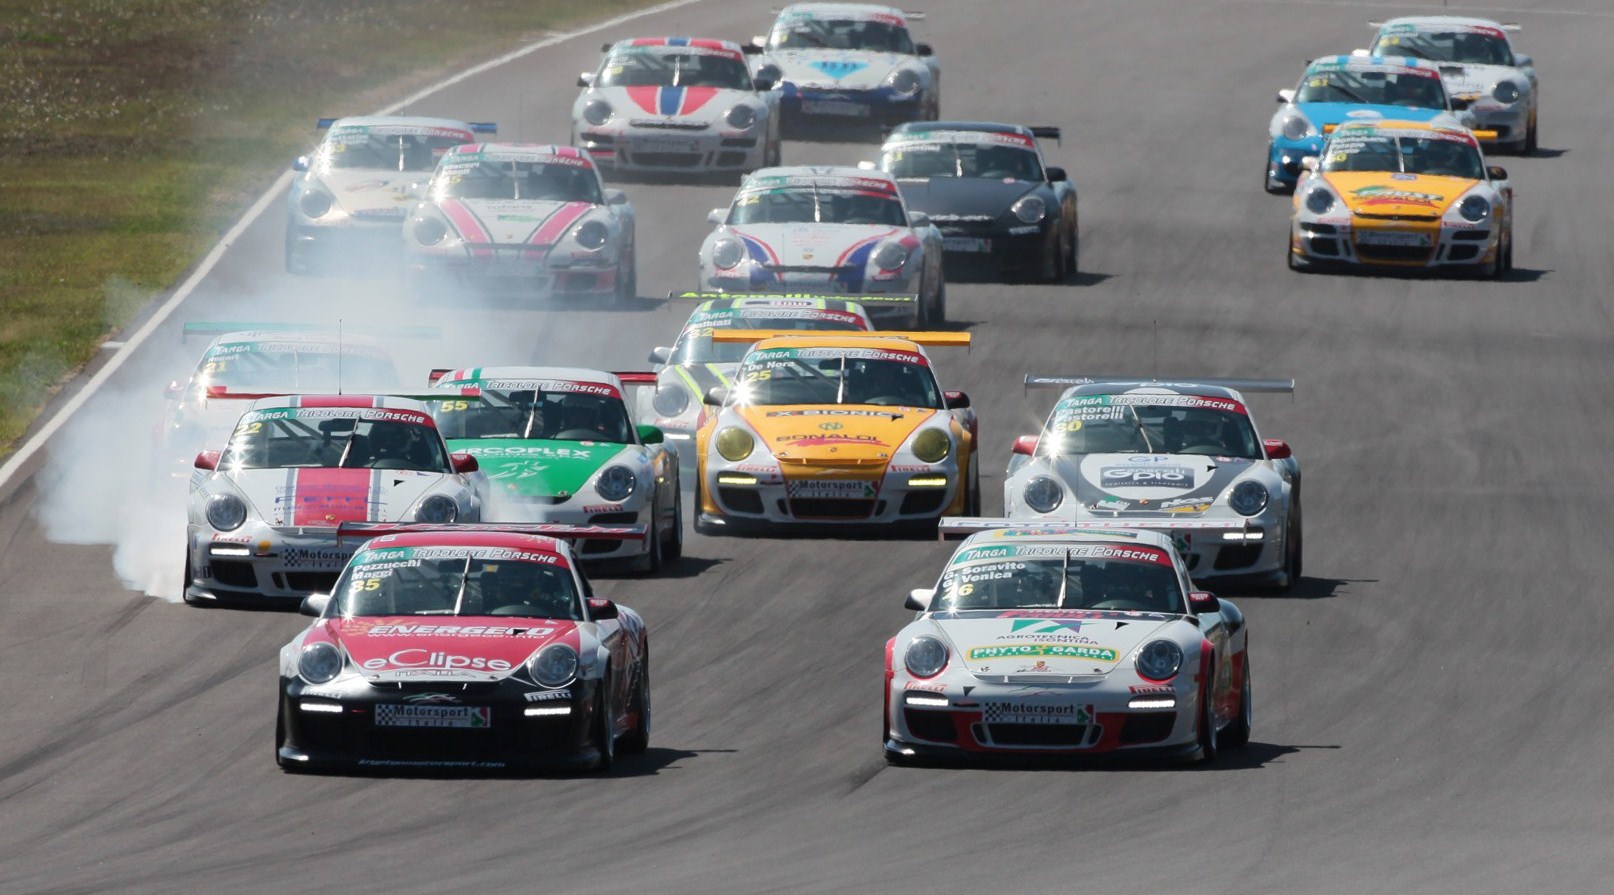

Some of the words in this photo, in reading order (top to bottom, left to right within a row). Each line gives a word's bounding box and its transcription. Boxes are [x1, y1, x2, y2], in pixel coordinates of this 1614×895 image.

[800, 310, 856, 323] PORSCHE
[755, 351, 791, 361] TARGA
[862, 349, 919, 363] PORSCHE
[767, 359, 795, 369] Nora
[746, 370, 771, 383] 25
[552, 381, 612, 396] PORSCHE
[440, 400, 468, 412] 55
[1066, 397, 1103, 407] TARGA
[1176, 397, 1236, 410] PORSCHE
[295, 408, 361, 419] TRICOLORE
[364, 409, 425, 424] PORSCHE
[233, 422, 262, 436] 22
[776, 434, 877, 442] BONALDI
[800, 480, 863, 493] Motorsport
[364, 550, 405, 563] TARGA
[411, 548, 486, 560] TRICOLORE
[490, 548, 558, 564] PORSCHE
[966, 549, 1007, 560] TARGA
[1014, 546, 1088, 557] TRICOLORE
[1093, 546, 1159, 562] PORSCHE
[353, 559, 420, 574] Pezzucchi
[962, 562, 1026, 575] Soravito
[351, 568, 393, 581] Maggi
[962, 572, 1013, 583] Venica
[973, 645, 1032, 656] PHYTO
[1052, 646, 1113, 658] GARDA
[363, 648, 512, 671] eClipse
[903, 680, 948, 692] PIRELLI
[1129, 684, 1175, 695] PIRELLI
[524, 688, 572, 702] PIRELLI
[393, 706, 469, 720] Motorsport
[1001, 702, 1075, 716] Motorsport
